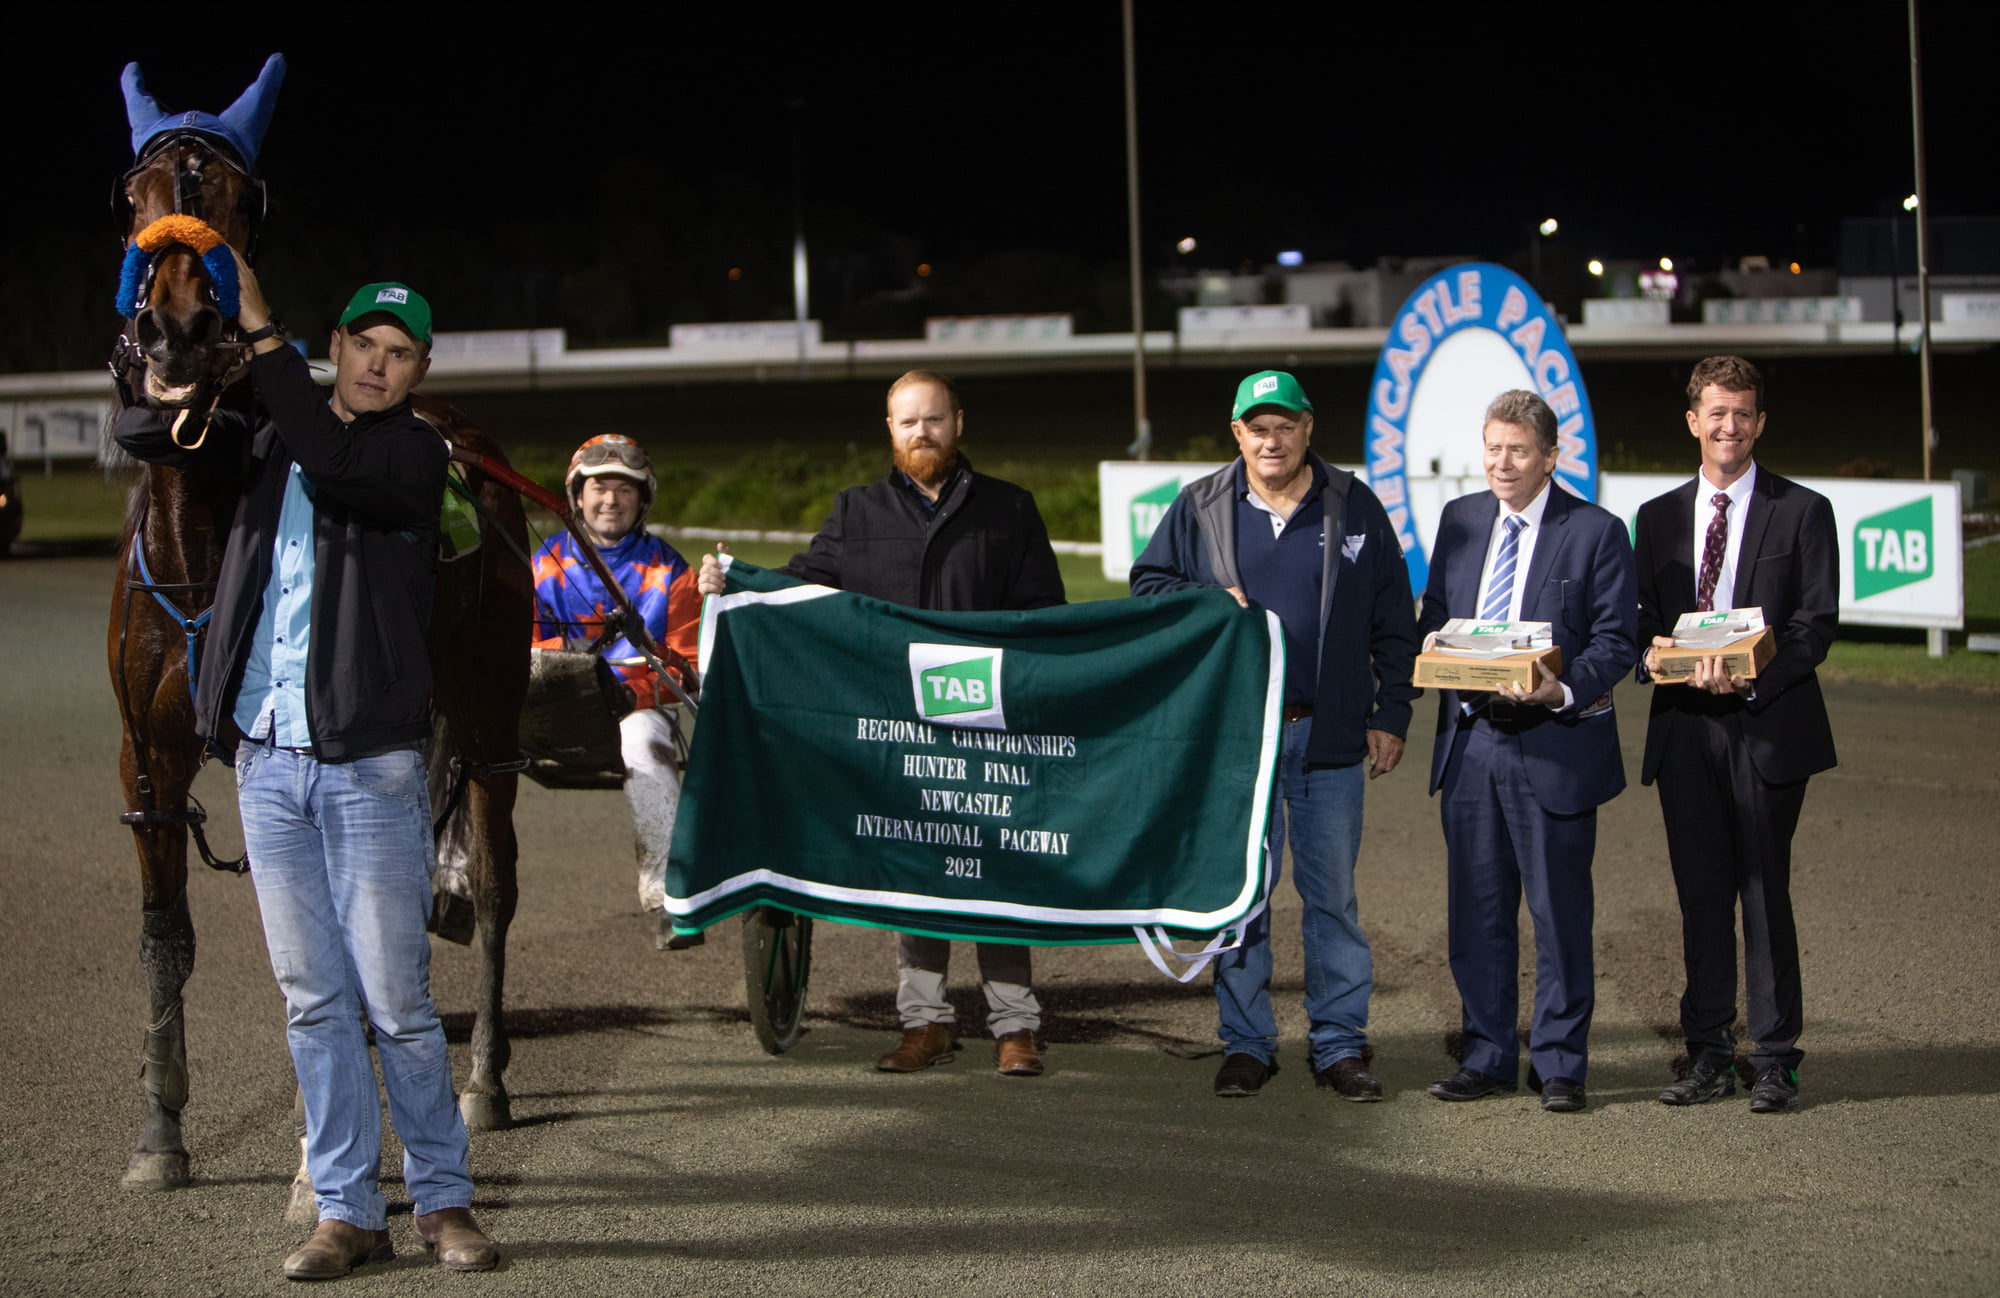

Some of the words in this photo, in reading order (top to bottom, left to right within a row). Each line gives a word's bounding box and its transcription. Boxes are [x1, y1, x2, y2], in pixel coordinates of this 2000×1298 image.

[381, 290, 405, 301] TAB
[1256, 379, 1277, 391] TAB
[1496, 285, 1590, 500] PACEW
[1132, 502, 1172, 538] TA
[1858, 527, 1928, 574] TAB
[1477, 624, 1506, 634] TAB
[1702, 615, 1726, 625] TAB
[926, 675, 987, 704] TAB
[857, 718, 936, 744] REGIONAL
[952, 729, 1076, 758] CHAMPIONSHIPS
[903, 754, 967, 780] HUNTER
[984, 761, 1030, 786] FINAL
[920, 789, 1013, 817] NEWCASTLE
[856, 814, 983, 847] INTERNATIONAL
[1000, 828, 1070, 855] PACEWAY
[945, 856, 982, 878] 2021
